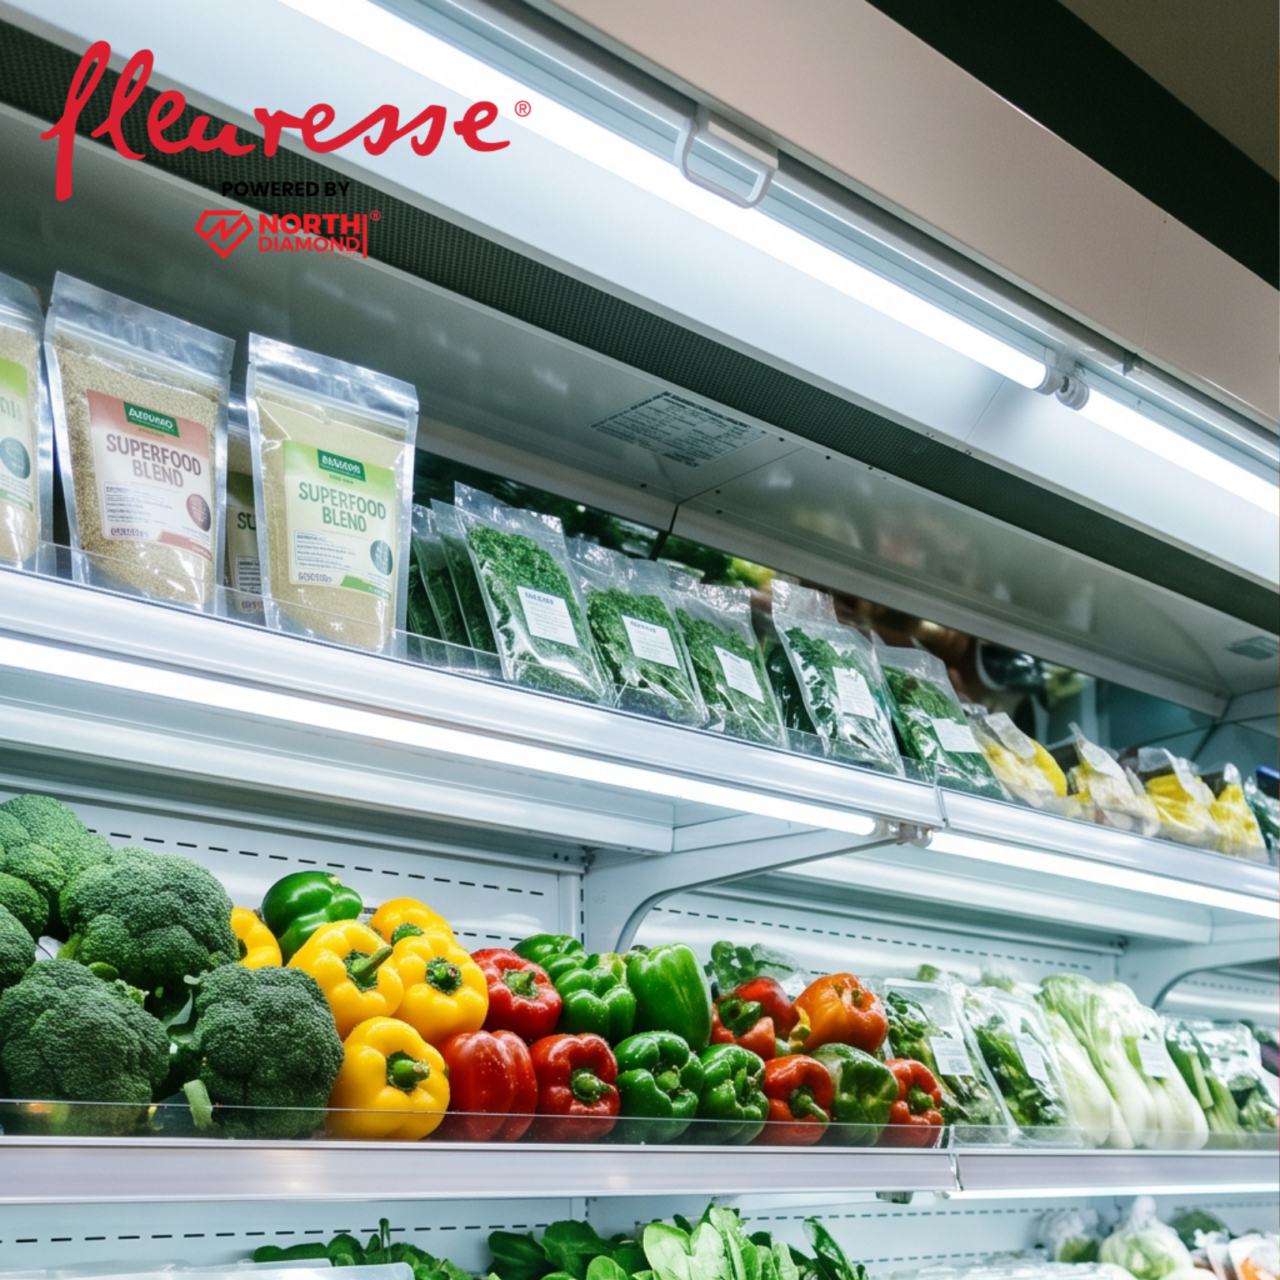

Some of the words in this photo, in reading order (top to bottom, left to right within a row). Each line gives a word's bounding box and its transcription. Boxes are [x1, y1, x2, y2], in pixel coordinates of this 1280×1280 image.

[106, 433, 202, 476] SUPERFOOD
[131, 459, 184, 488] BLEND
[298, 481, 387, 521] SUPERFOOD
